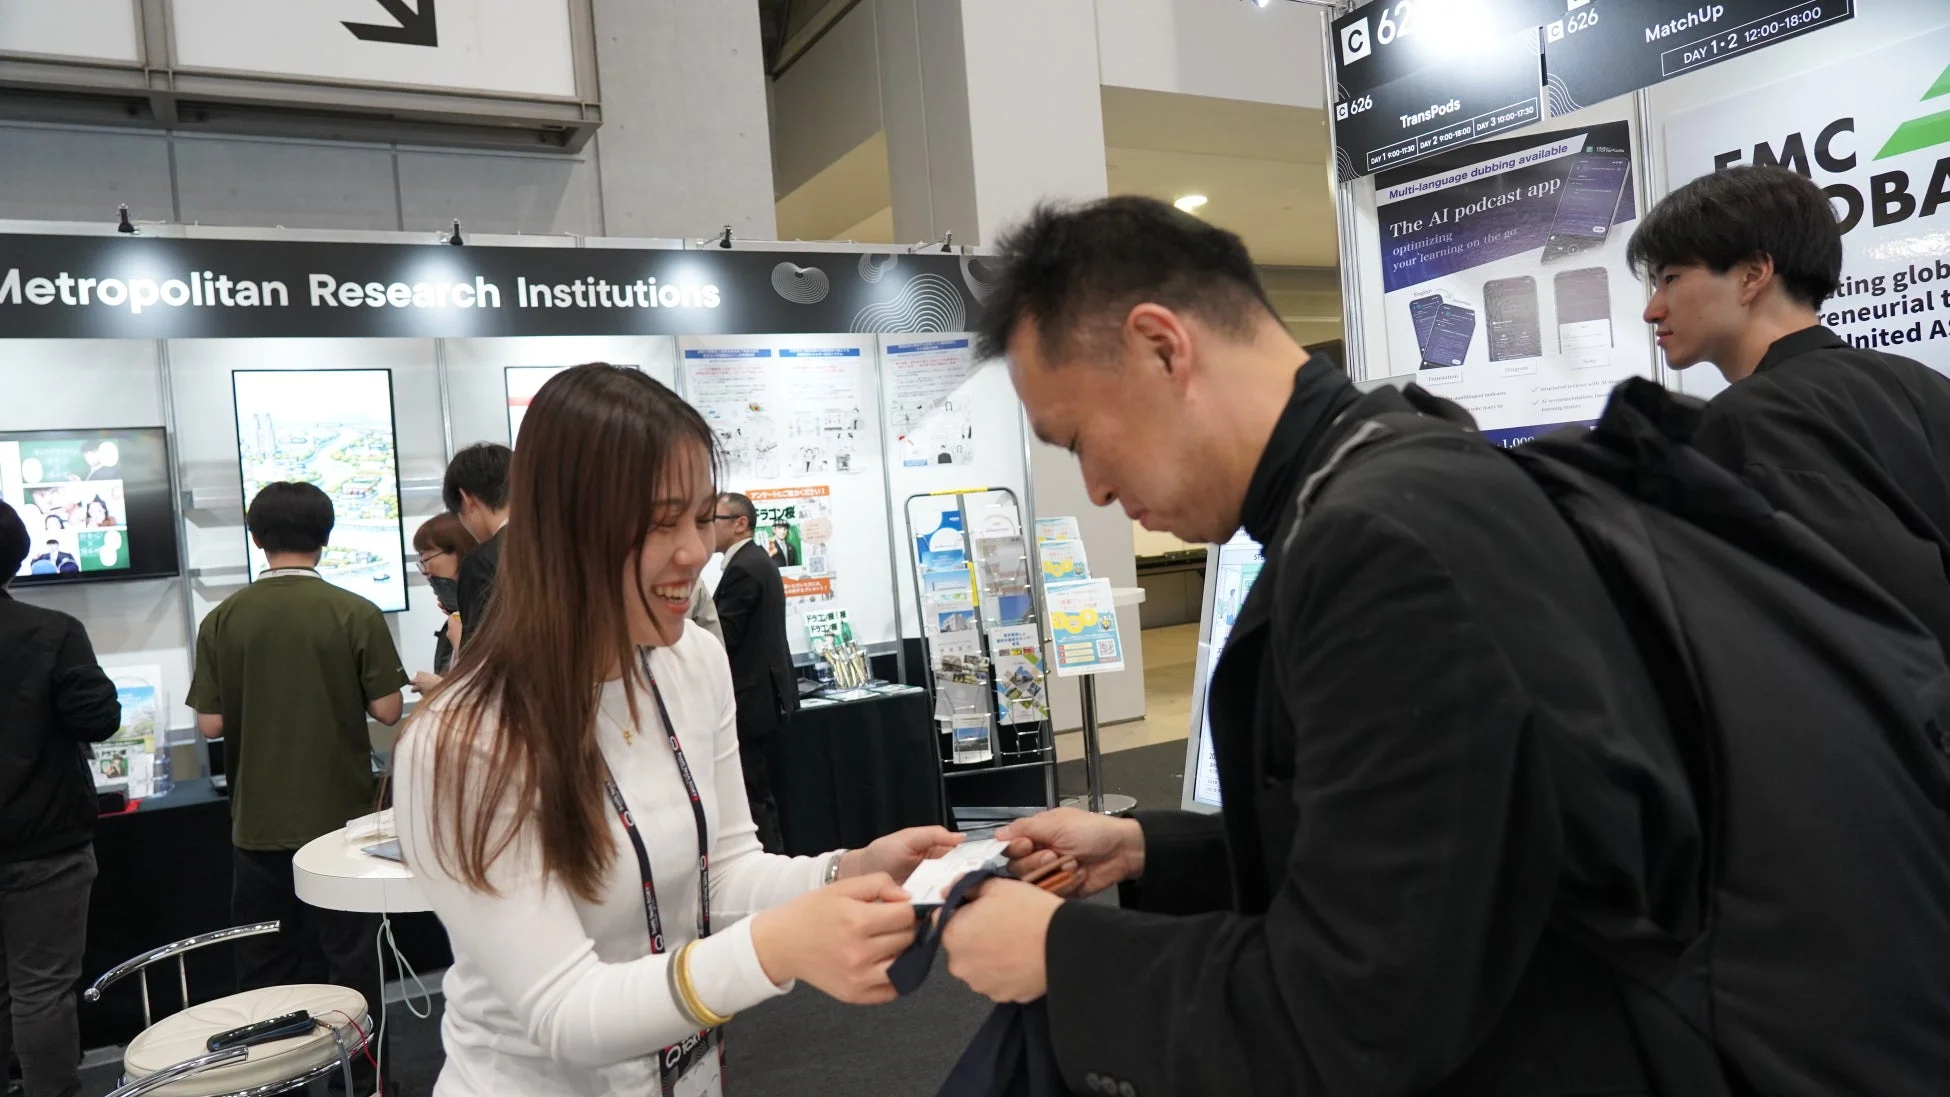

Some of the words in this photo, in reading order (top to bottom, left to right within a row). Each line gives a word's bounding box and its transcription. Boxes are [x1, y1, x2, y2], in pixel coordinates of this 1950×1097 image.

[1567, 7, 1599, 34] 626
[1645, 3, 1724, 44] MatchUp
[1347, 29, 1364, 54] C
[1684, 46, 1707, 64] DAY
[1744, 6, 1822, 43] 12:00-18:00
[1350, 95, 1373, 115] 626
[1400, 98, 1461, 129] TransPods
[1476, 122, 1489, 131] DAY
[1490, 117, 1496, 126] 3
[1420, 140, 1432, 149] DAY
[1432, 136, 1438, 145] 2
[1370, 156, 1382, 165] DAY
[1389, 171, 1468, 200] Multi-language
[1471, 159, 1515, 178] dubbing
[1518, 144, 1568, 165] available
[1389, 219, 1423, 238] The
[1428, 207, 1449, 228] AI
[1454, 186, 1522, 224] podcast
[1527, 178, 1561, 199] app
[1392, 231, 1453, 257] optimizing
[1392, 256, 1417, 272] your
[1419, 243, 1464, 263] learning
[1466, 239, 1480, 249] on
[1483, 231, 1501, 244] the
[1503, 228, 1517, 240] go
[0, 267, 289, 315] Metropolitan
[308, 273, 501, 310] Research
[518, 276, 721, 310] Institutions
[1827, 275, 1887, 299] ting
[1929, 319, 1950, 340] A
